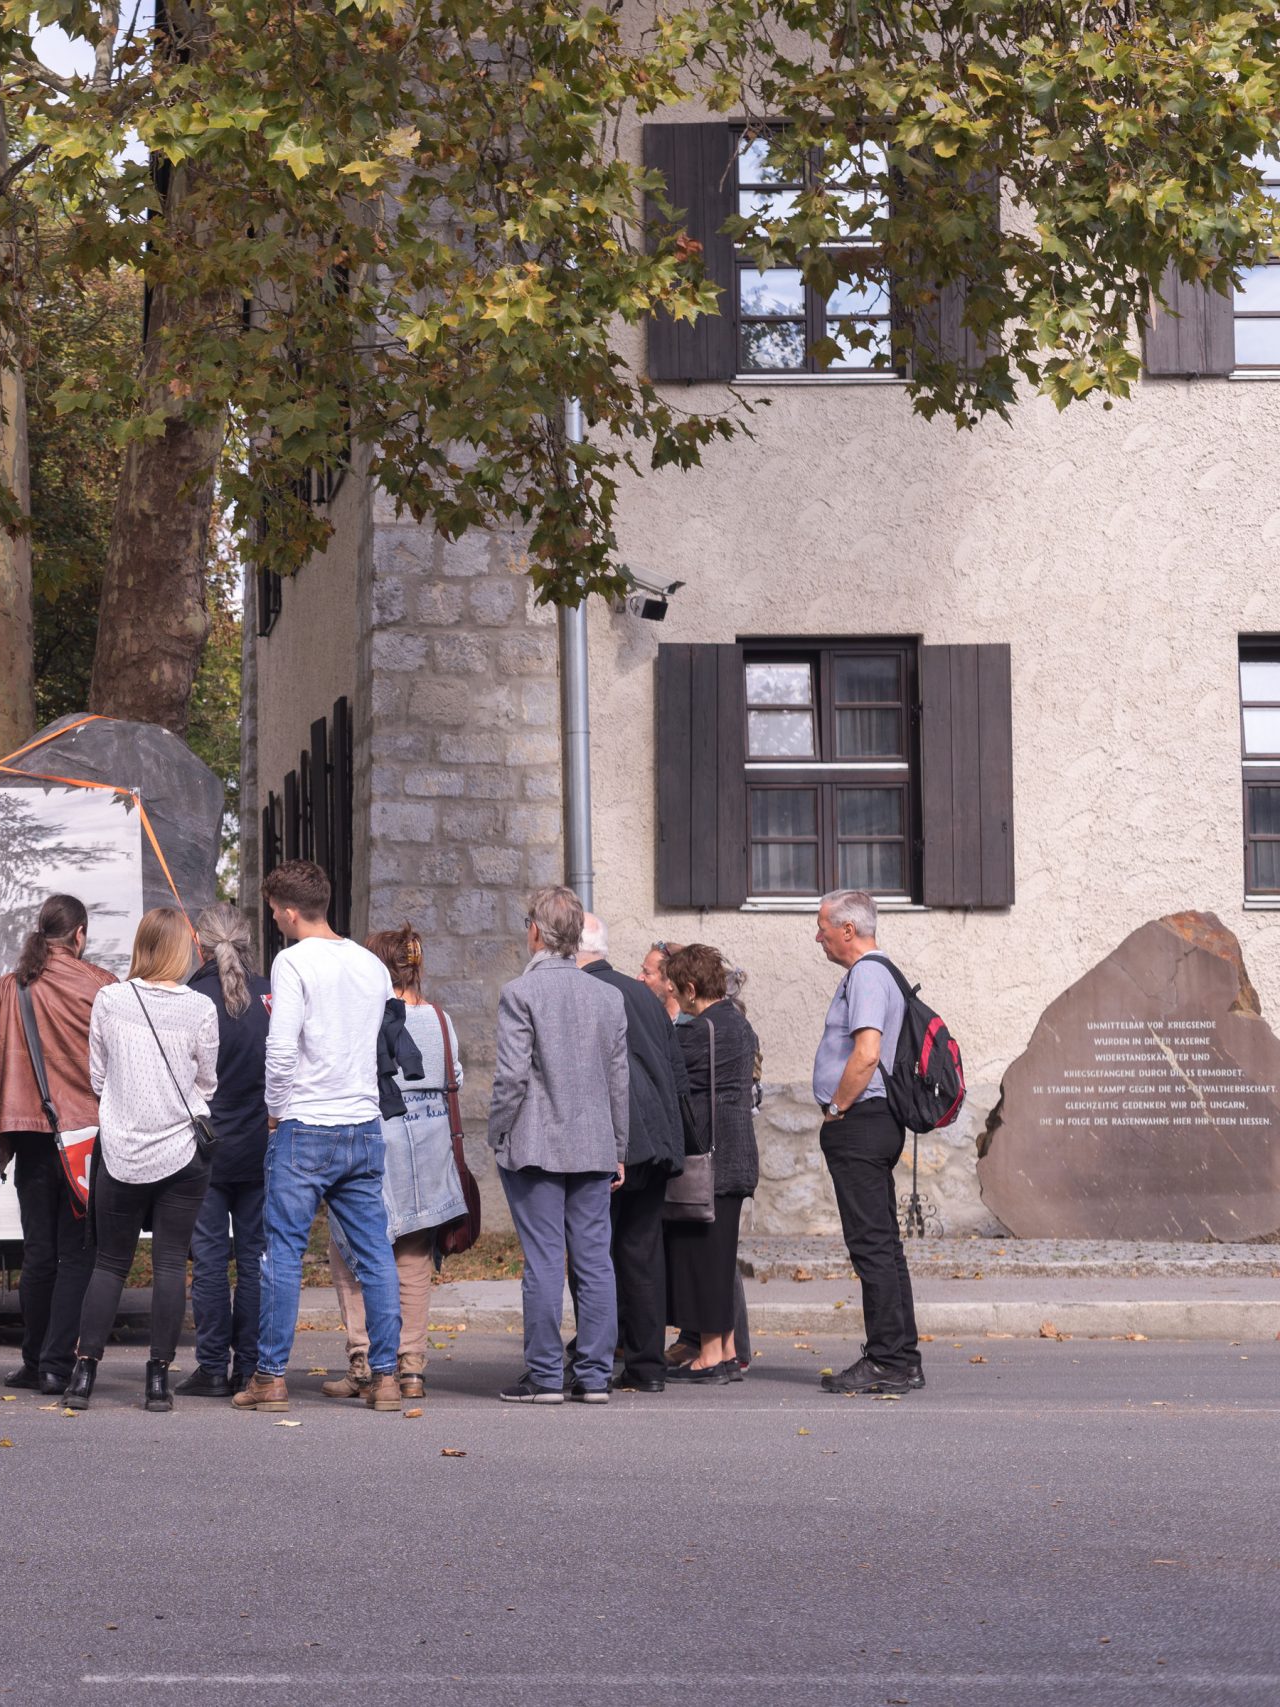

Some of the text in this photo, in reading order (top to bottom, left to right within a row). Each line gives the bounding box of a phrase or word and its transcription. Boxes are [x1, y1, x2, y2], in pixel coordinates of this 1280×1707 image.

[1168, 1021, 1216, 1029] KRIEGSENDE
[1095, 1053, 1189, 1061] WIDERSTANDSKÄMFER
[1186, 1069, 1195, 1077] SS
[1198, 1069, 1245, 1077] ERMORDET.
[1040, 1118, 1052, 1126] DIE
